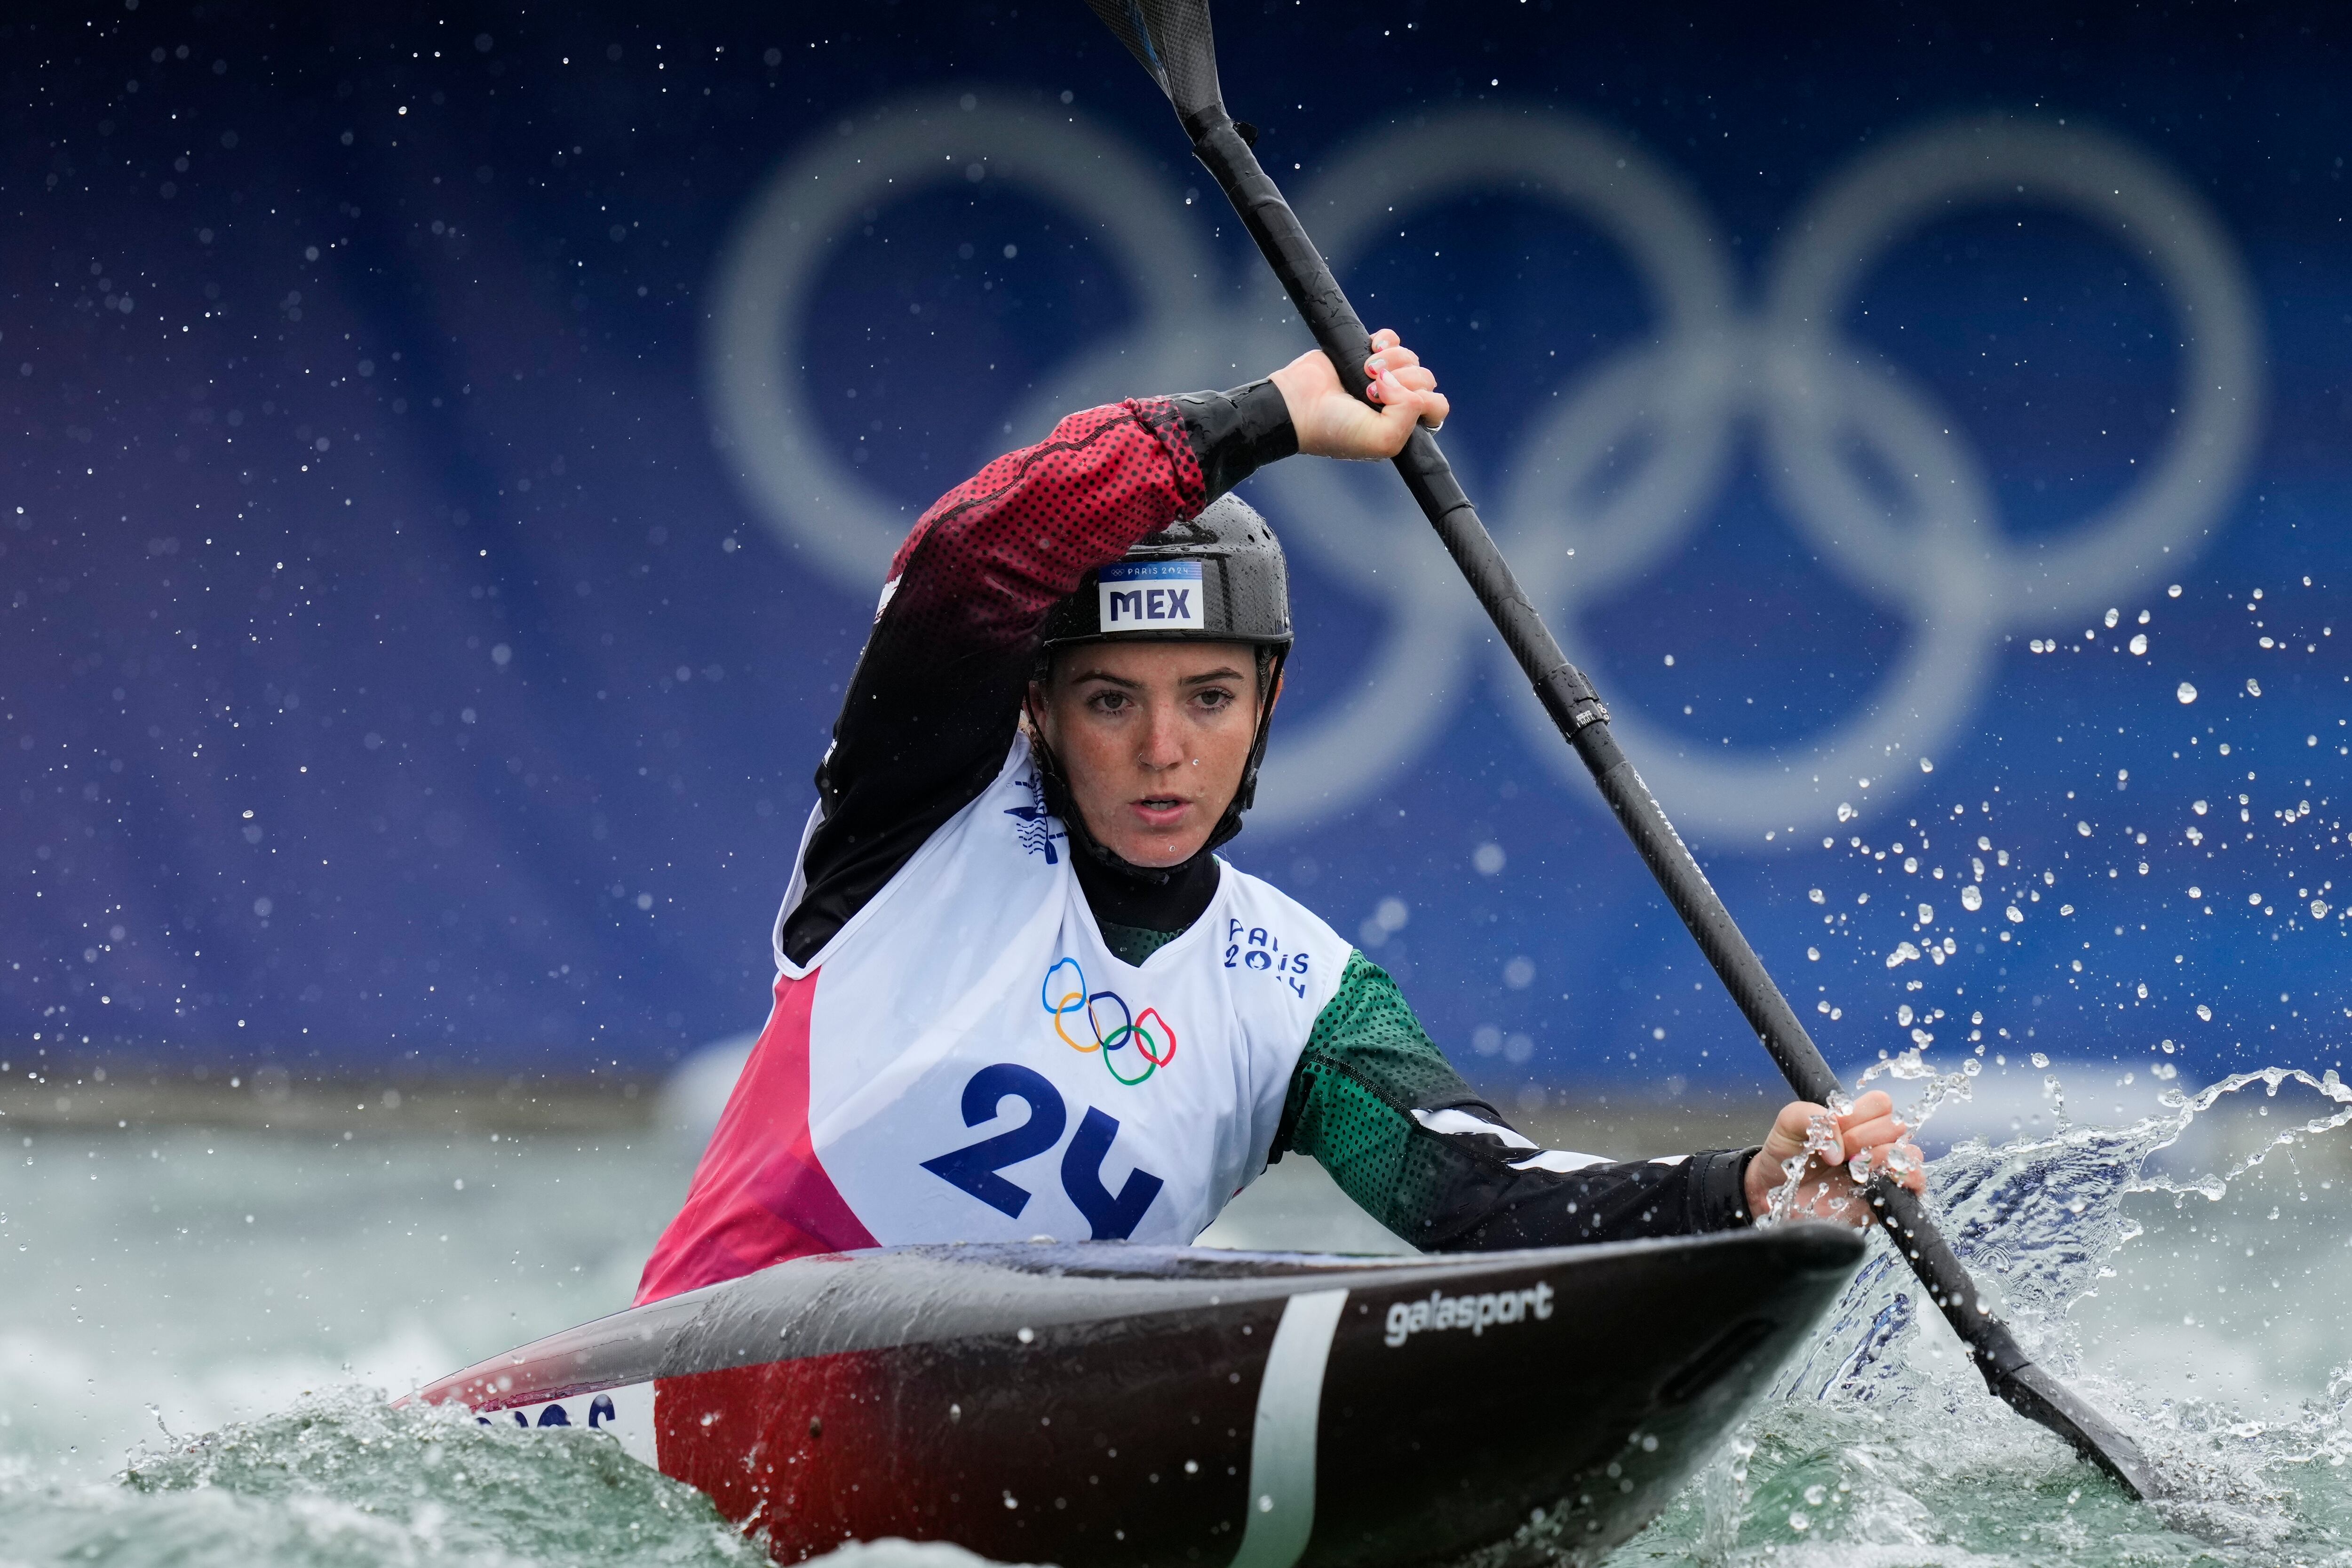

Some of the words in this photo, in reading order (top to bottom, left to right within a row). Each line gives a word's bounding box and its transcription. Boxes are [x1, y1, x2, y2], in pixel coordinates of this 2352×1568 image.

[1110, 589, 1191, 621] MEX
[1650, 799, 1685, 847] PARIS
[1224, 944, 1306, 999] 204
[919, 1063, 1164, 1241] 24
[1384, 1281, 1554, 1347] galasport
